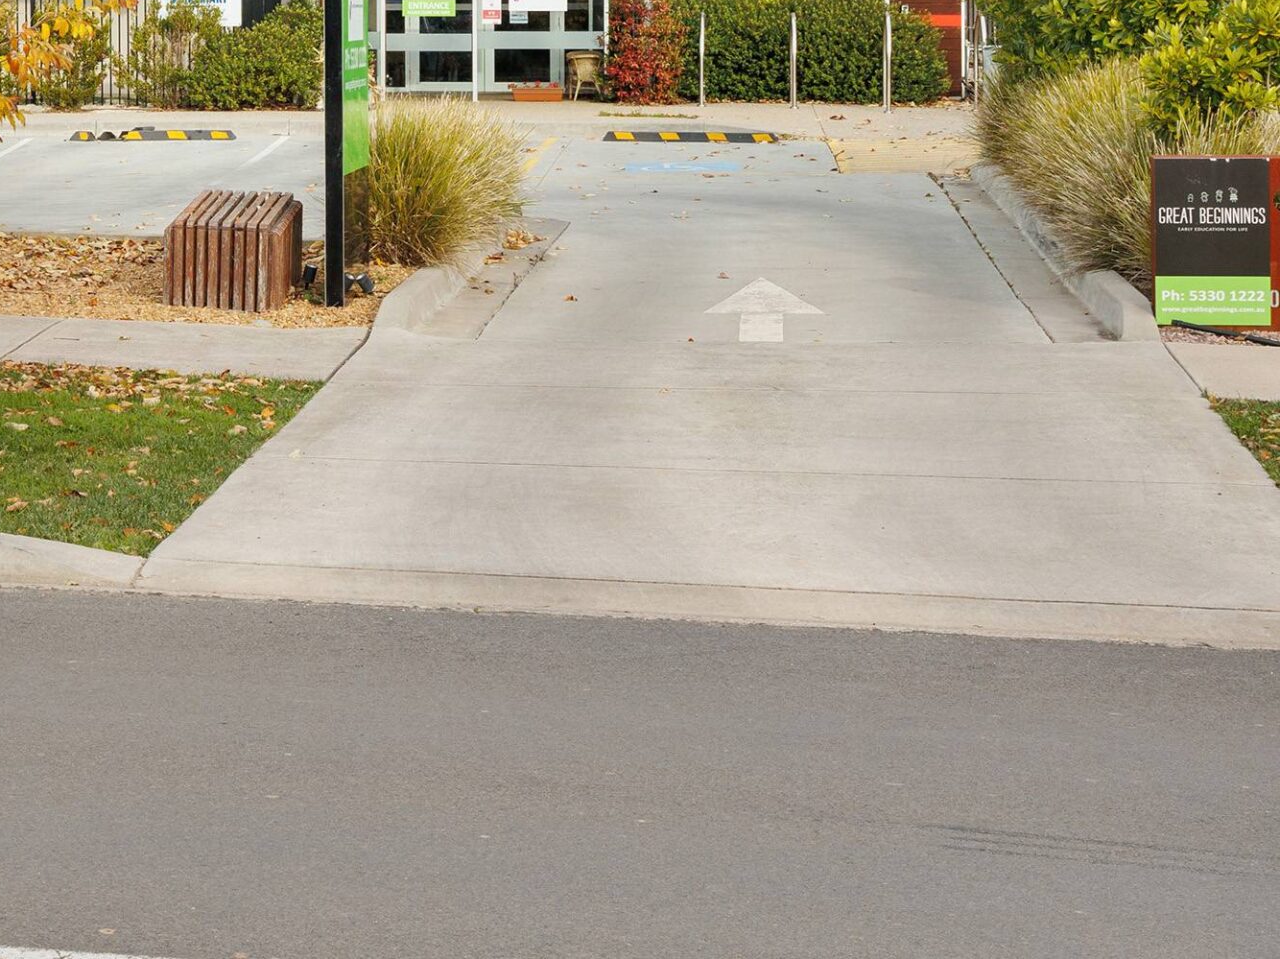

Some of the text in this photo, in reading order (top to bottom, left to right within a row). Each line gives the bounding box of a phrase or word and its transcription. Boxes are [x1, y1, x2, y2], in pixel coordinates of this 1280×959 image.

[1158, 207, 1266, 224] GREAT BEGINNINGS
[1161, 289, 1266, 302] Ph: 5330 1222
